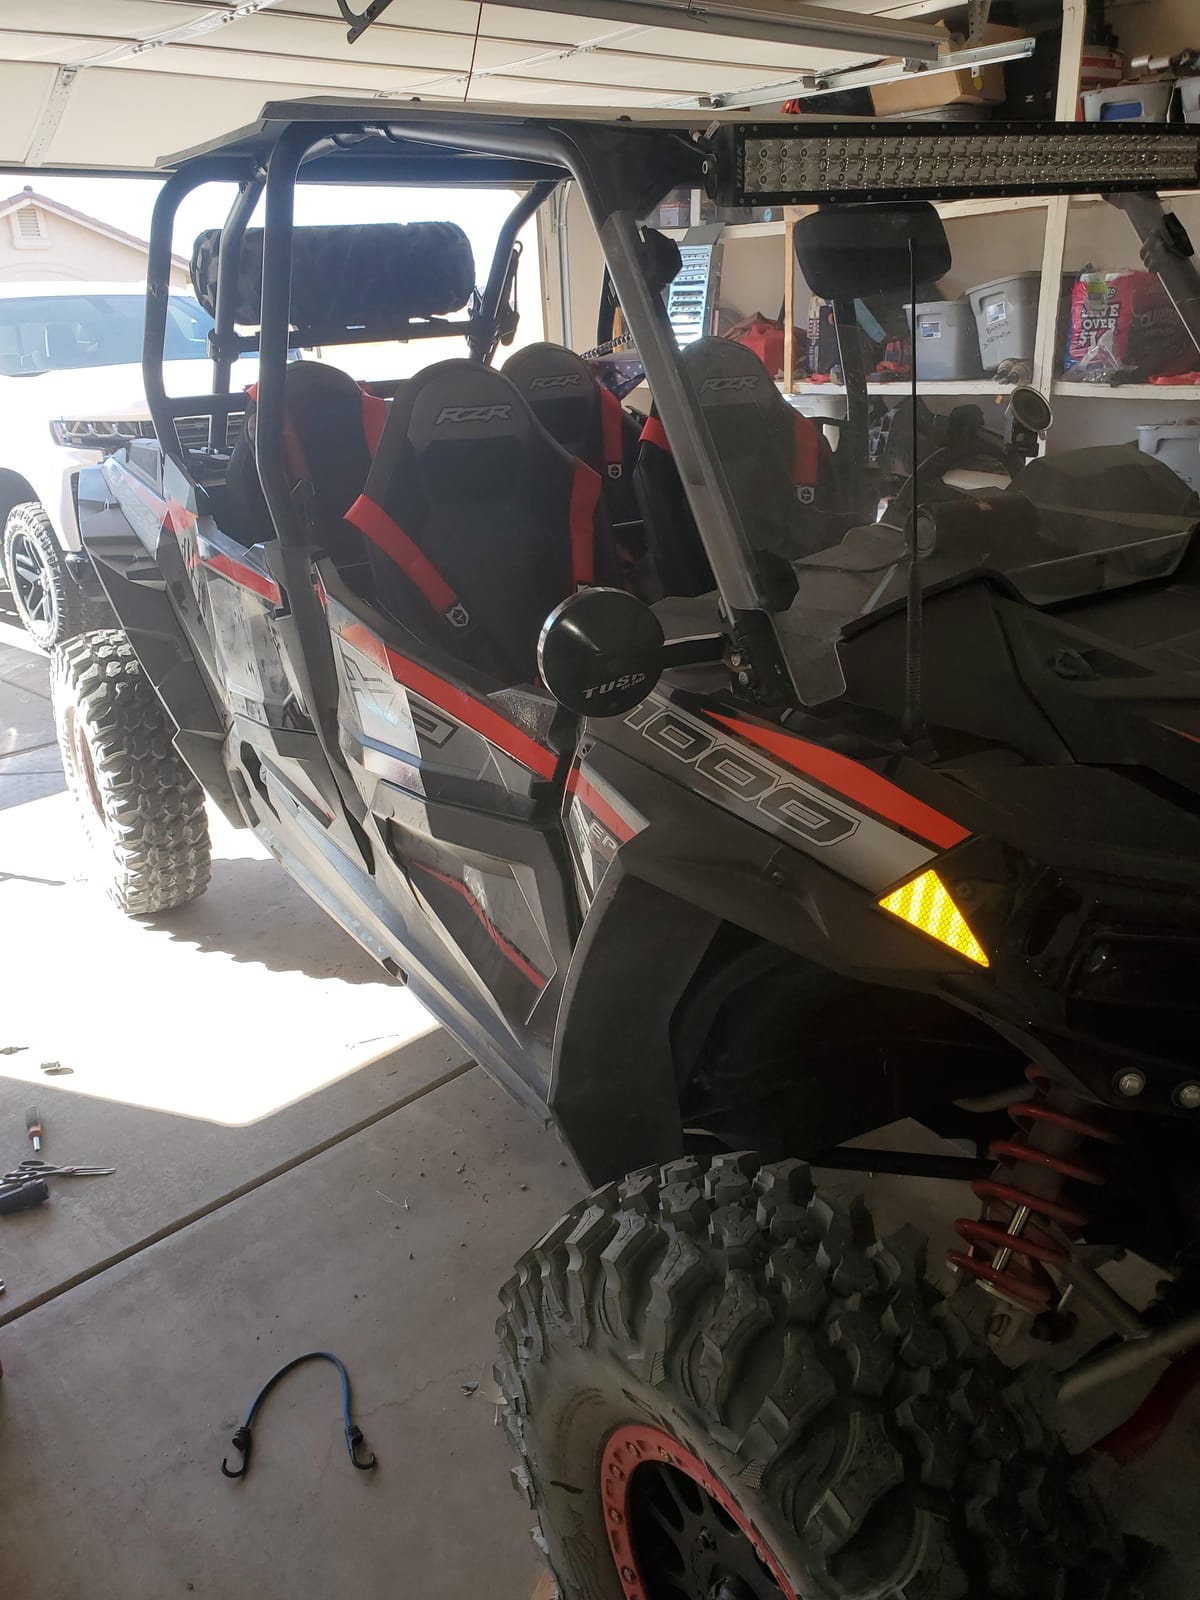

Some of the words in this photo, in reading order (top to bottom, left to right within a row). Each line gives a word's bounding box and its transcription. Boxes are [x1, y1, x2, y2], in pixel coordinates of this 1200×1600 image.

[1083, 318, 1116, 330] OVER
[529, 374, 580, 391] RZR
[700, 375, 759, 394] RZR
[434, 404, 512, 426] RZR
[623, 697, 861, 847] 1000
